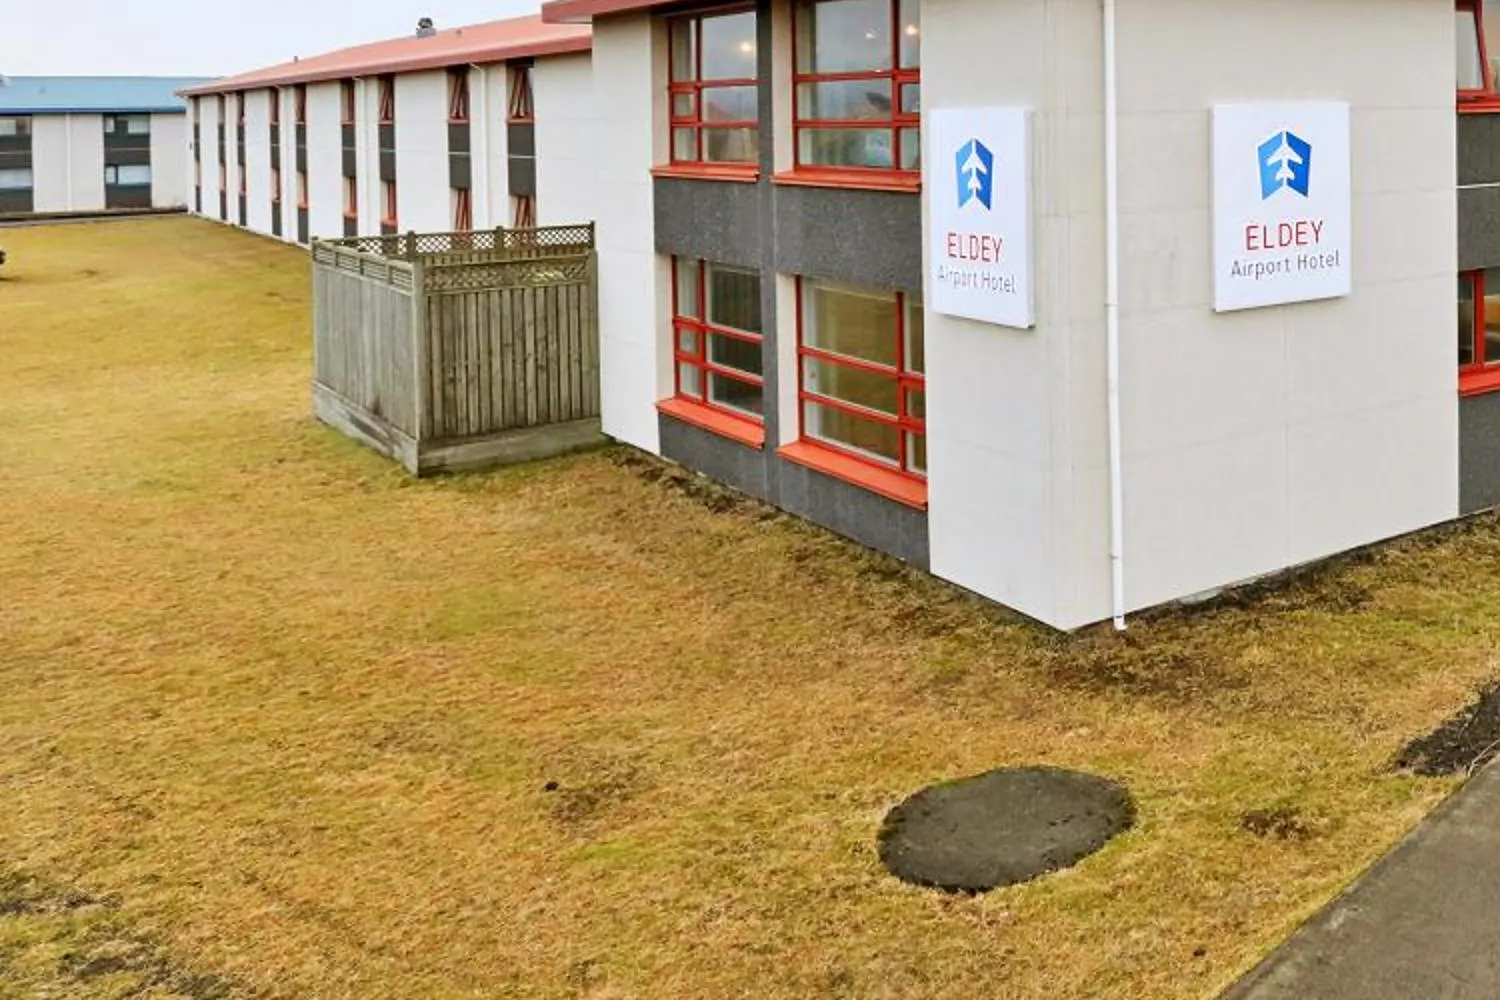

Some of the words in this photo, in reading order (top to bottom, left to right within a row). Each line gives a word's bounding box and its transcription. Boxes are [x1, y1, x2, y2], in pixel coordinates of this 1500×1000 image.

[947, 232, 1003, 263] ELDEY
[1245, 220, 1323, 251] ELDEY
[937, 265, 978, 290] Airport
[980, 272, 1016, 295] Hotel
[1230, 258, 1290, 280] Airport
[1297, 250, 1340, 270] Hotel
